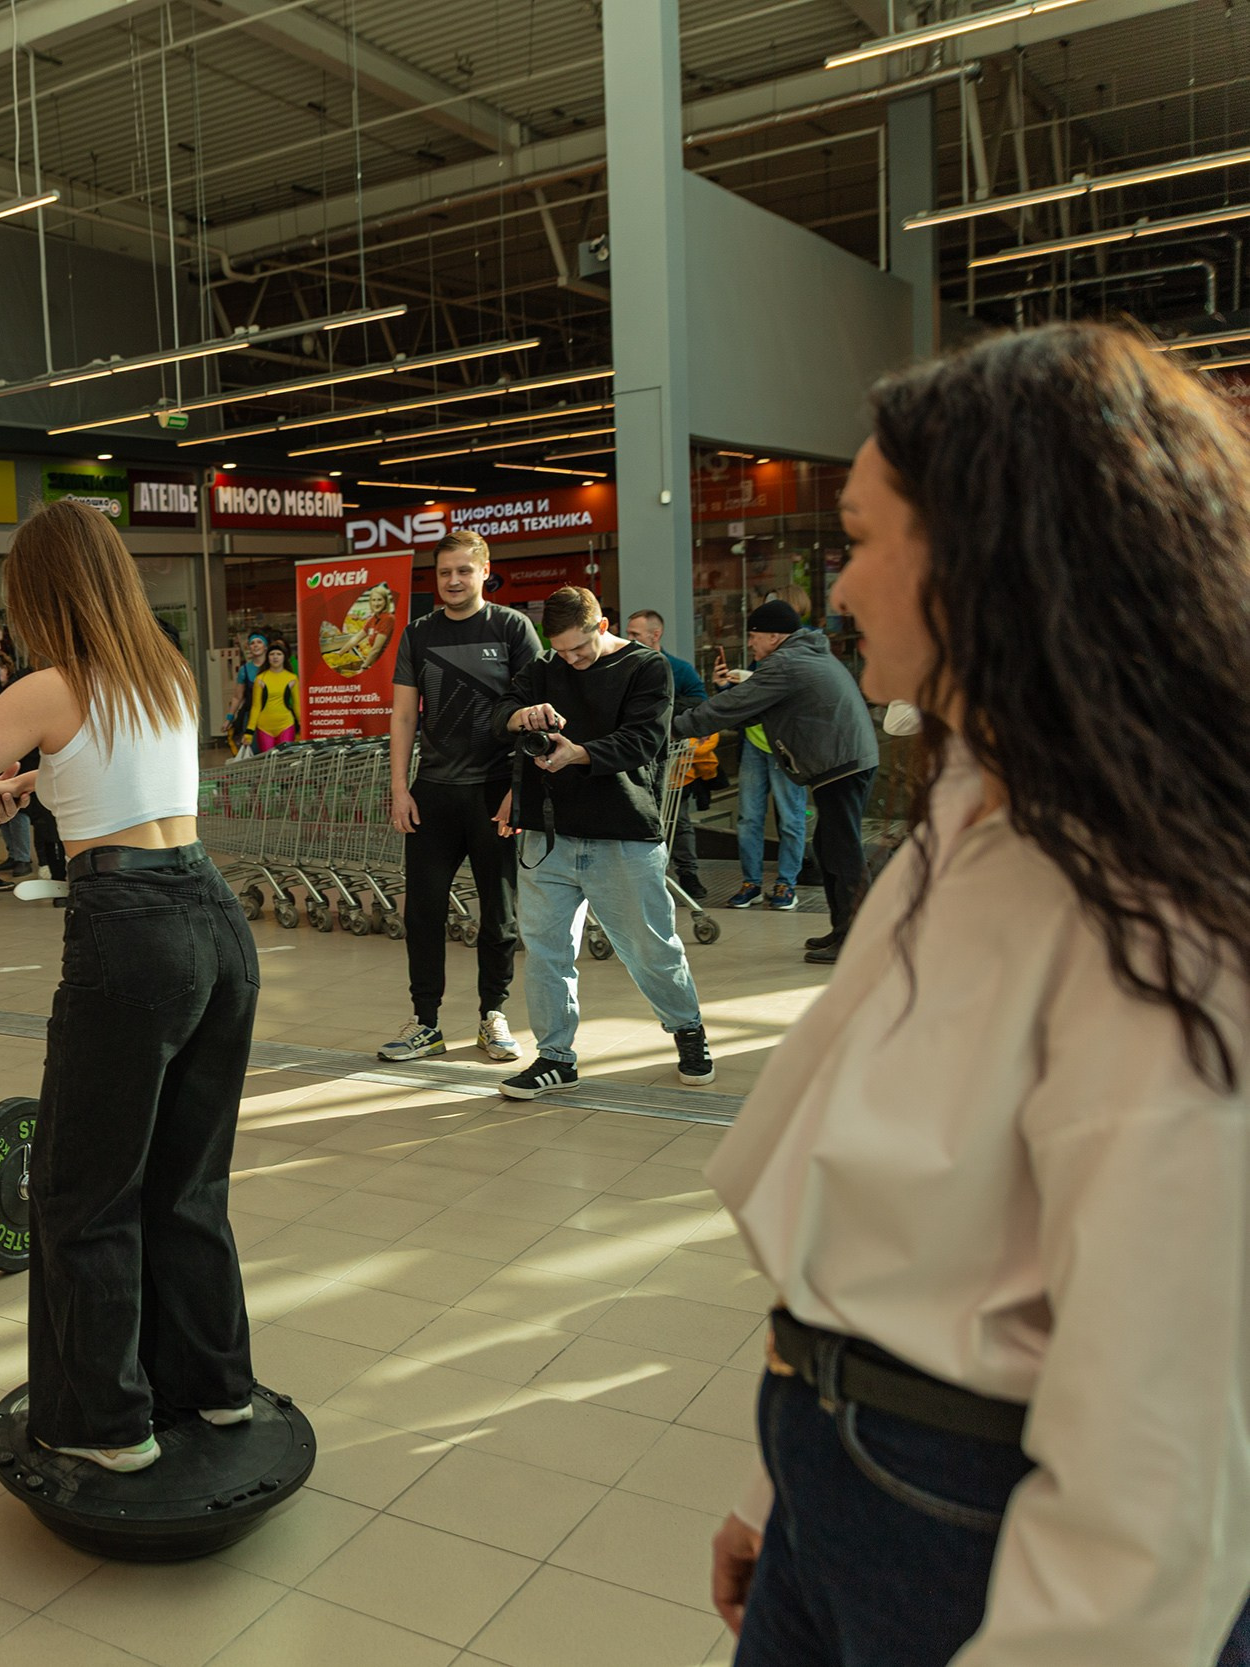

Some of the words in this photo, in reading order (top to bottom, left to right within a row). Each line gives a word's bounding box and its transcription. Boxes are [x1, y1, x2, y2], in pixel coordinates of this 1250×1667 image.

[137, 481, 199, 514] АТЕЛЬЕ
[217, 485, 282, 515] МНОГО
[283, 489, 344, 518] МЕБЕЛИ
[450, 501, 533, 524] ЦИФРОВАЯ
[537, 498, 549, 513] И
[522, 510, 593, 532] ТЕХНИКА
[346, 511, 447, 550] DNS
[309, 684, 361, 694] ПРИГЛАШАЕМ
[315, 694, 352, 704] КОМАНДУ
